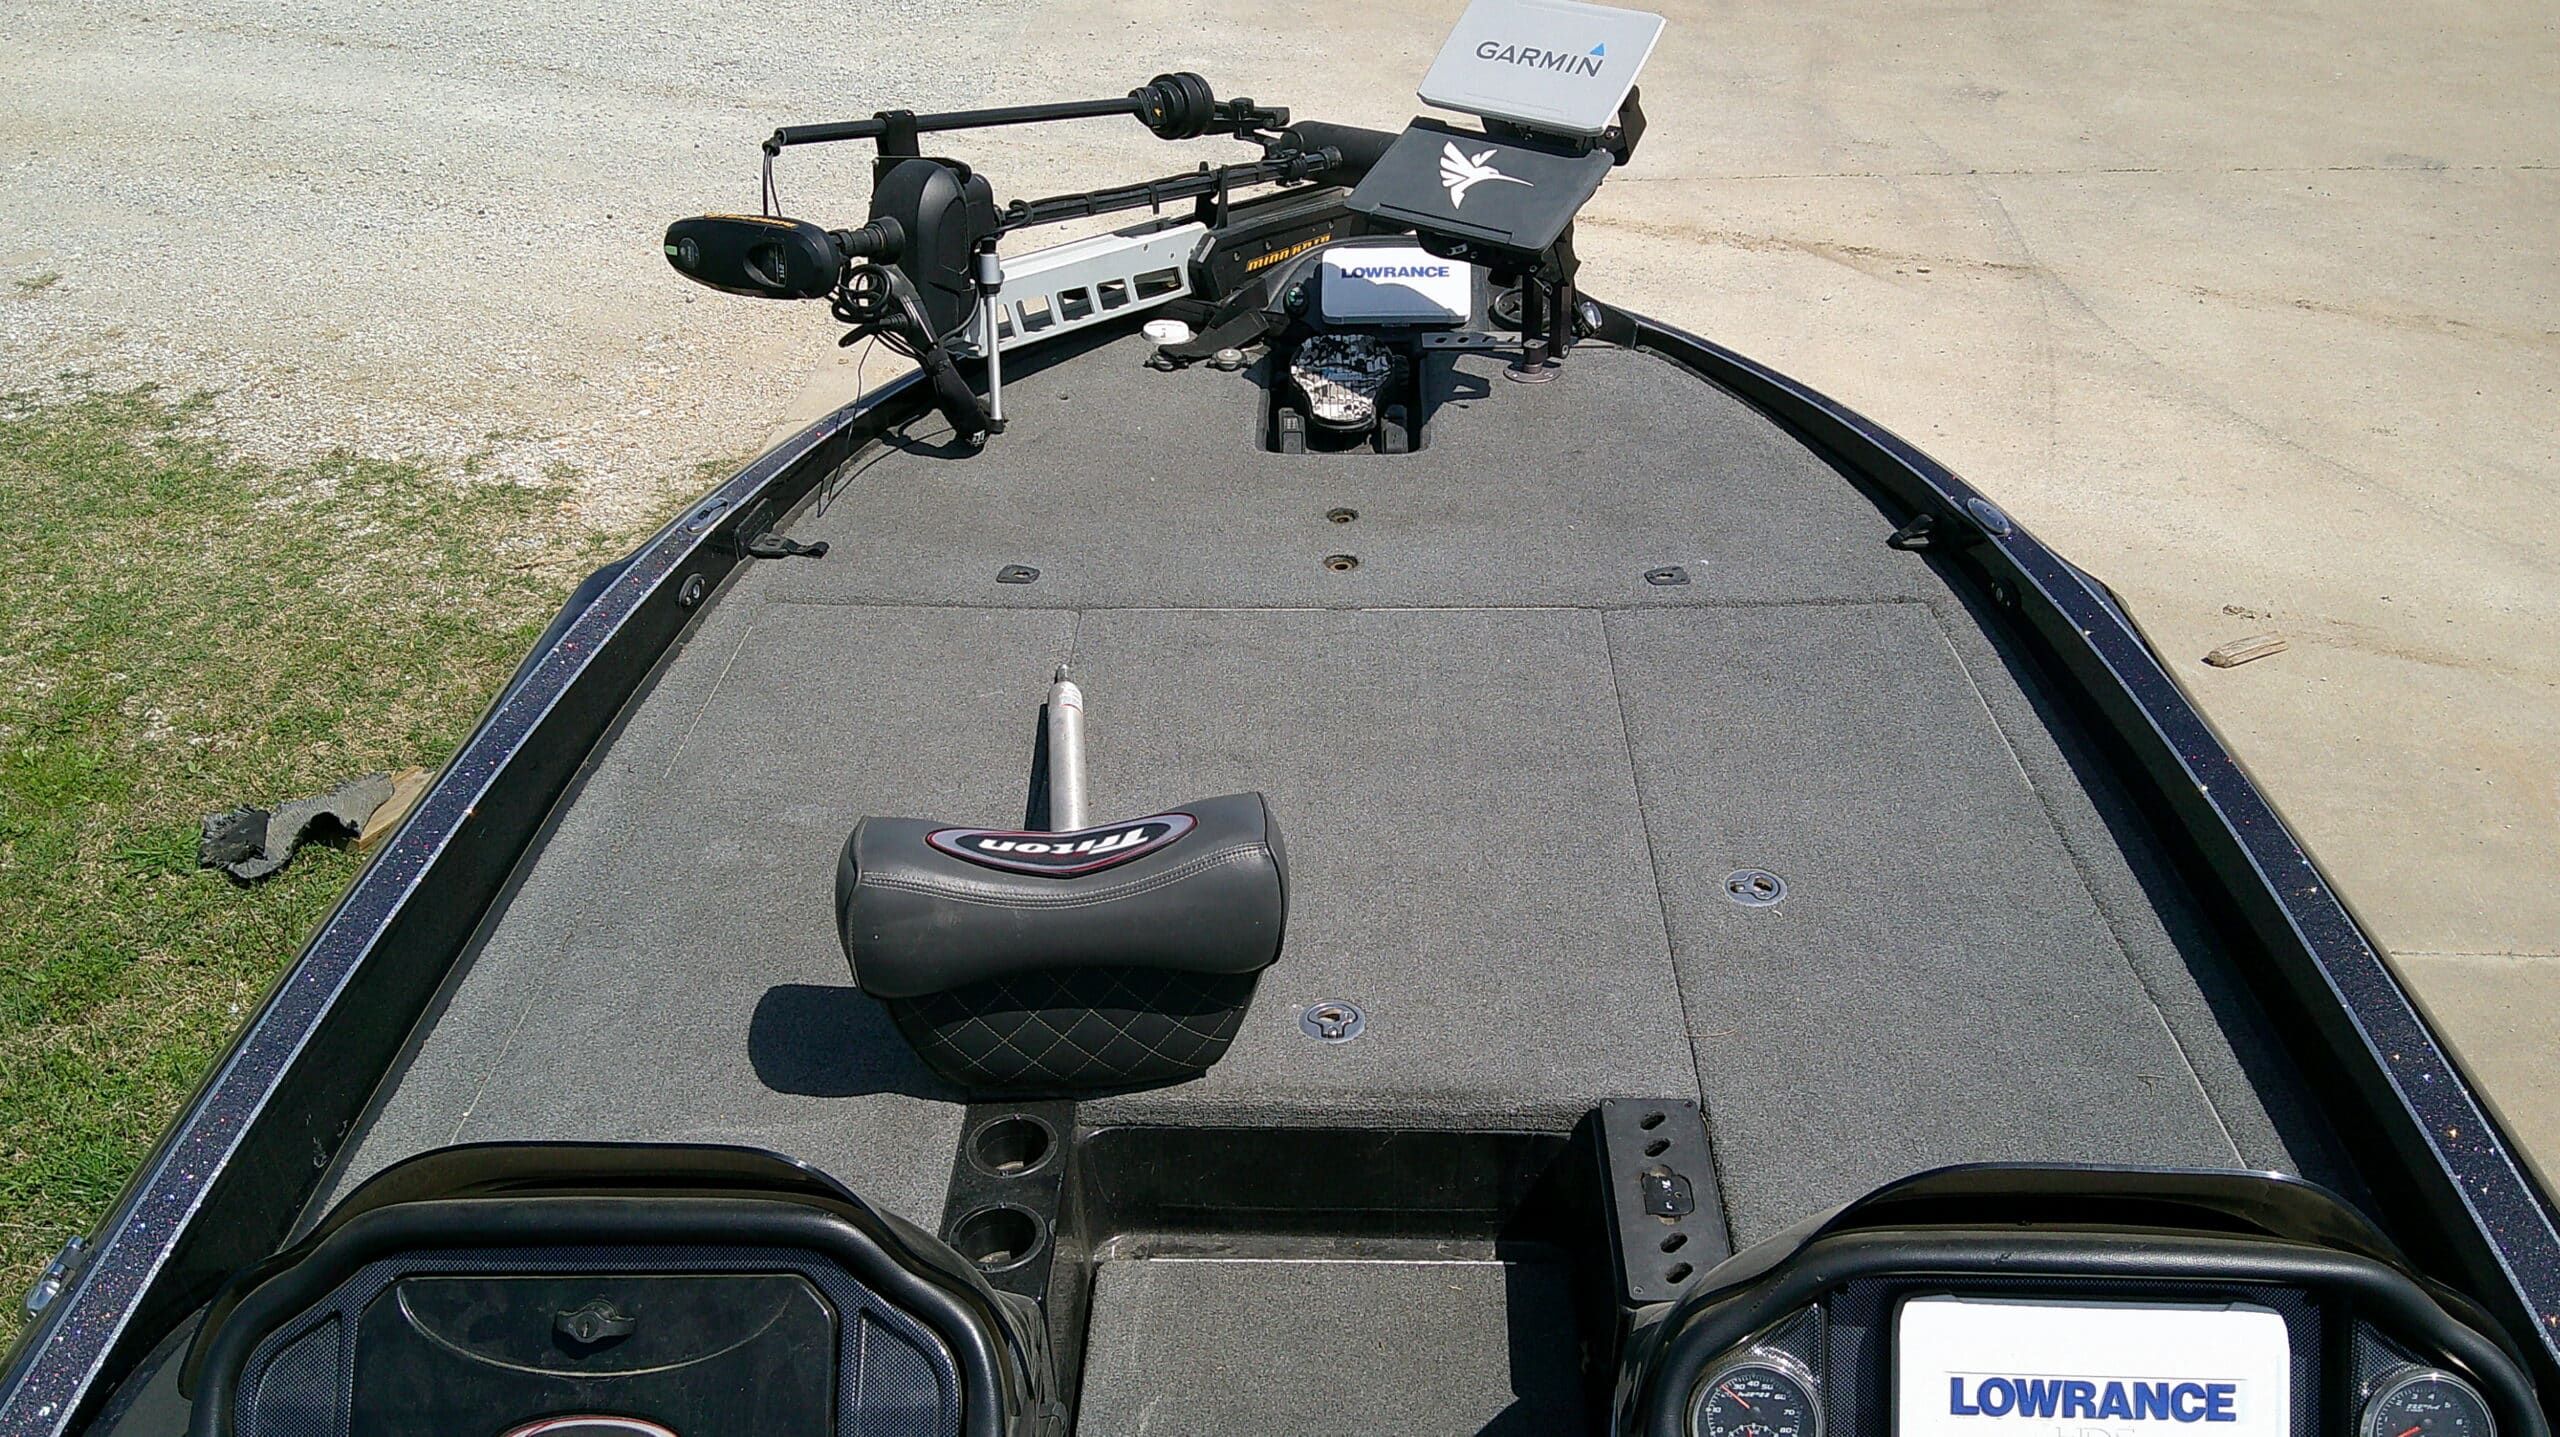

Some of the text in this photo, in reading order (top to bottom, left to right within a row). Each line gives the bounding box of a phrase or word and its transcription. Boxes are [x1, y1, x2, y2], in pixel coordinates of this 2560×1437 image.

[1475, 41, 1603, 78] GARMIN
[1341, 266, 1450, 278] LOWRANCE
[978, 827, 1150, 855] Triton
[1950, 1377, 2237, 1422] LOWRANCE
